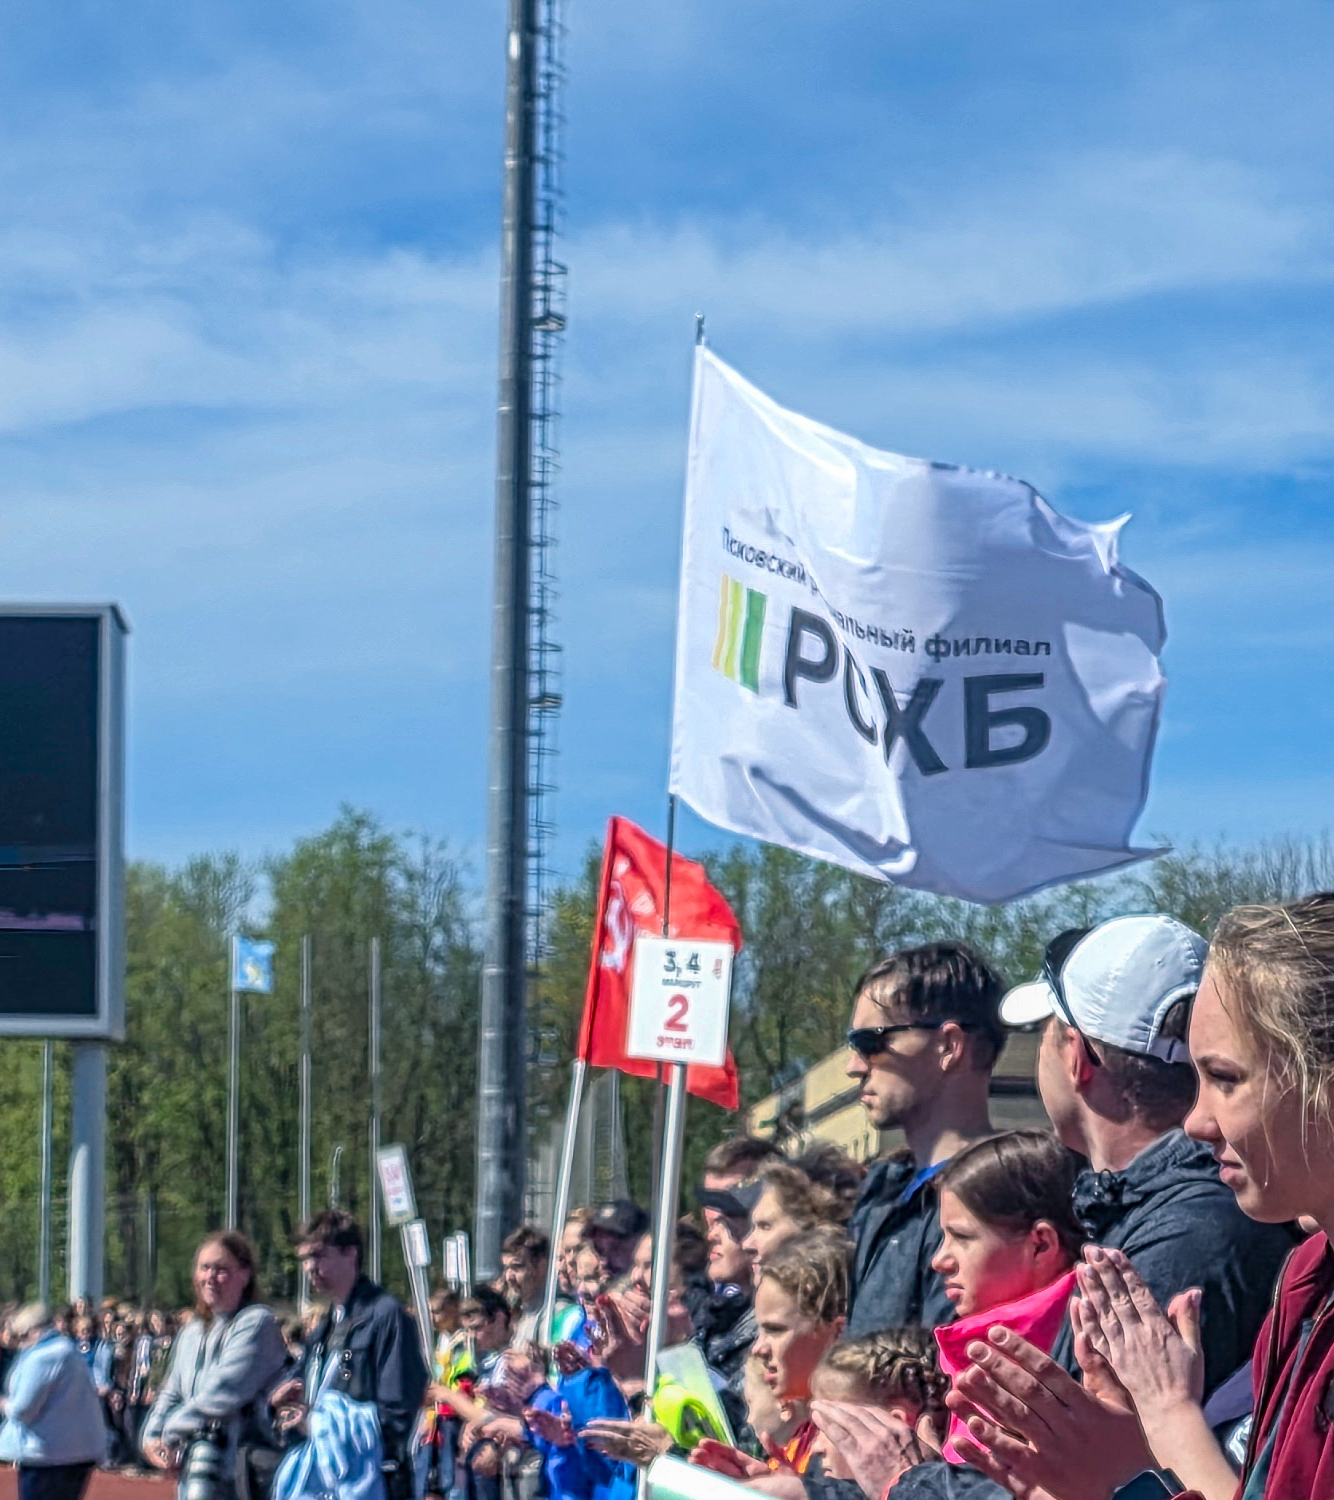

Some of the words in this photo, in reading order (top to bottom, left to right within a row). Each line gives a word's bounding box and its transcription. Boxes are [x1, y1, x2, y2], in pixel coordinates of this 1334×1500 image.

[924, 633, 1051, 664] филиал
[783, 605, 1052, 777] РСХБ
[664, 993, 689, 1032] 2
